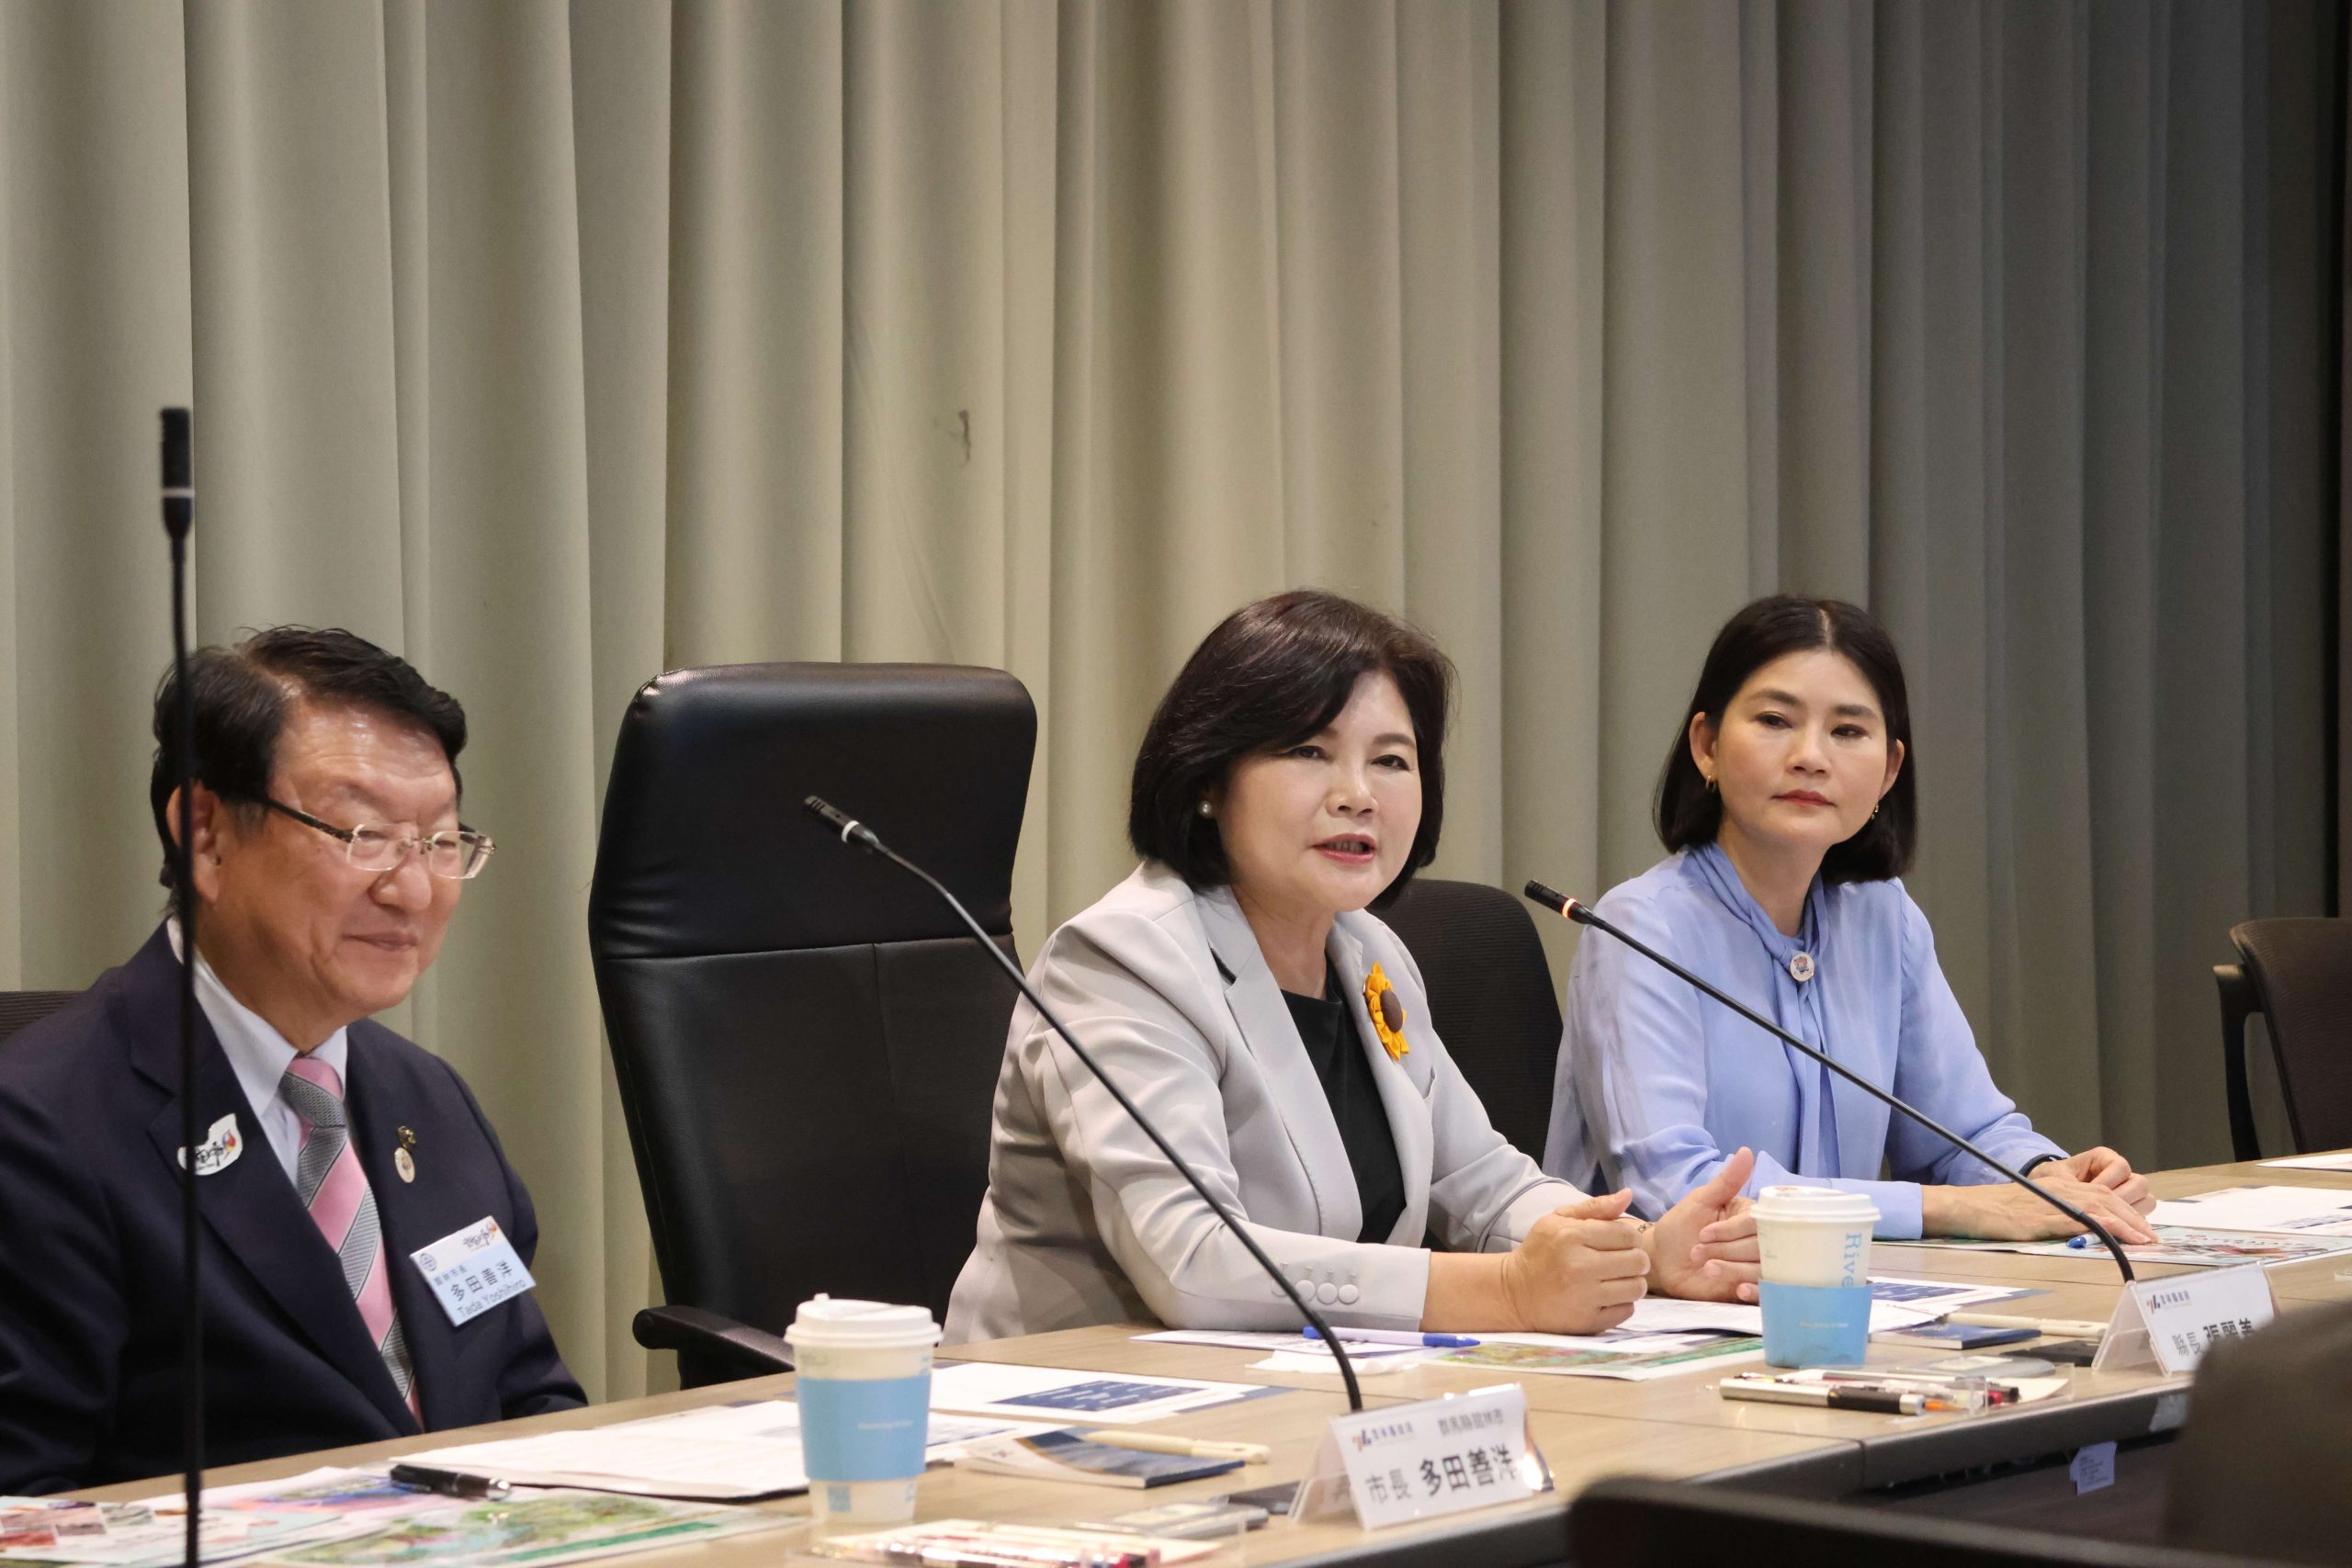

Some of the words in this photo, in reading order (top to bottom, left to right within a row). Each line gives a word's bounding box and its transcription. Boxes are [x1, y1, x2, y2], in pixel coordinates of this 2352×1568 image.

[458, 1301, 483, 1316] Tada
[481, 1280, 526, 1303] Yoshihiro
[1365, 1468, 1412, 1505] 市長
